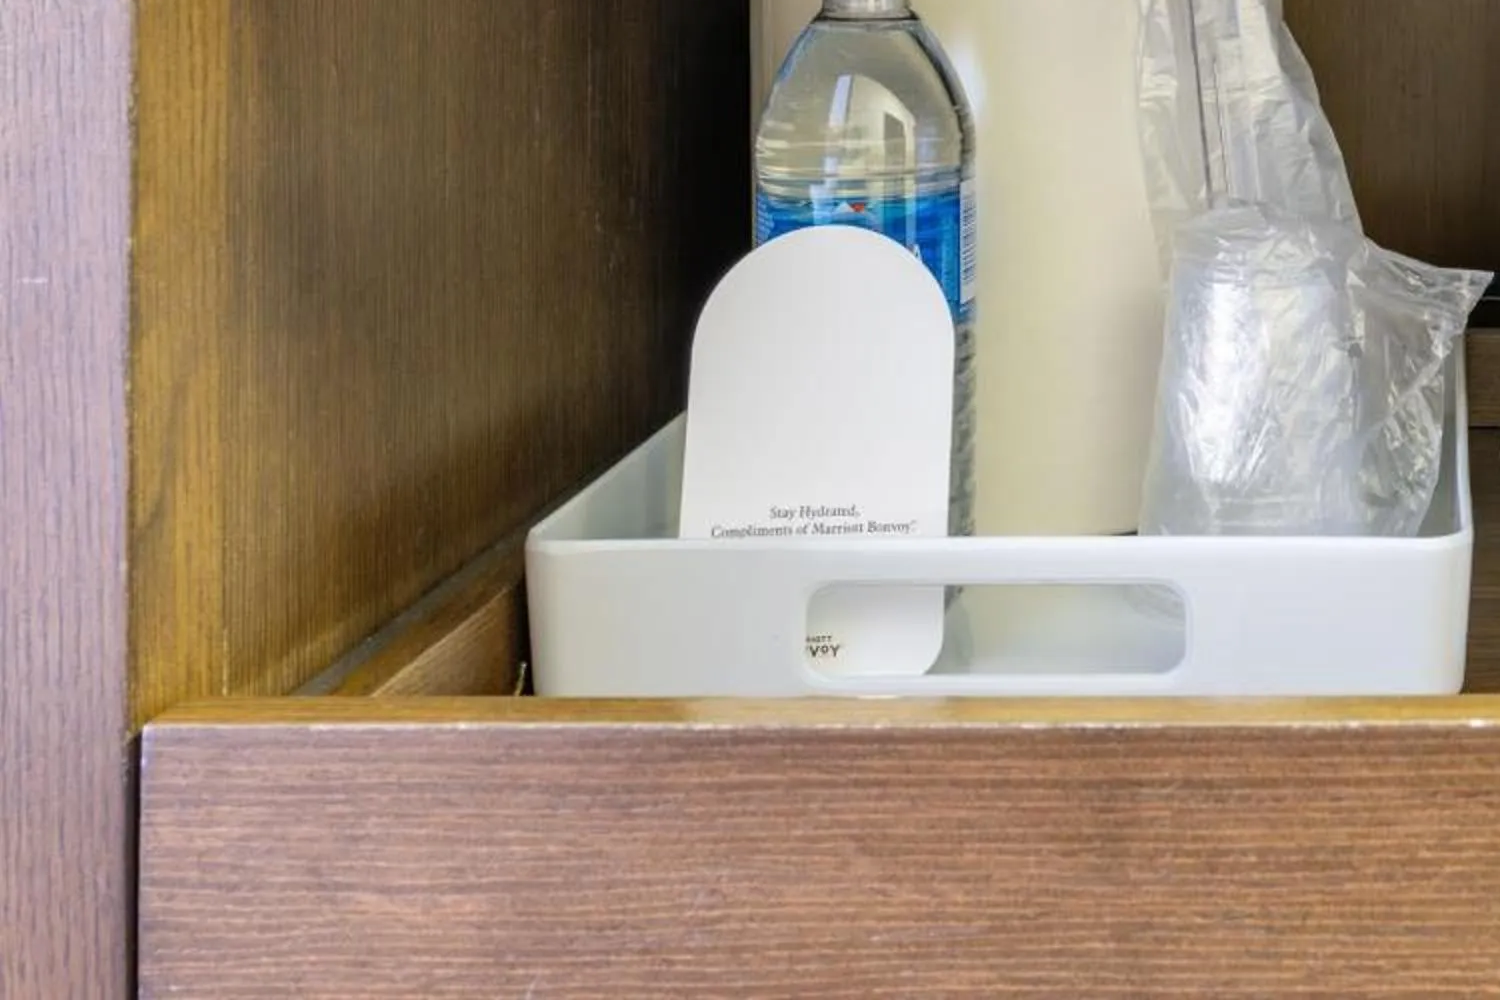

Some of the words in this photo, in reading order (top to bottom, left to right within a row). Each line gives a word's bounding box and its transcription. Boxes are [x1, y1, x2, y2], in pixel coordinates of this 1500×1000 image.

[770, 505, 796, 520] Stay
[711, 524, 794, 540] Compliments
[796, 523, 807, 534] of
[811, 520, 863, 535] Marriott
